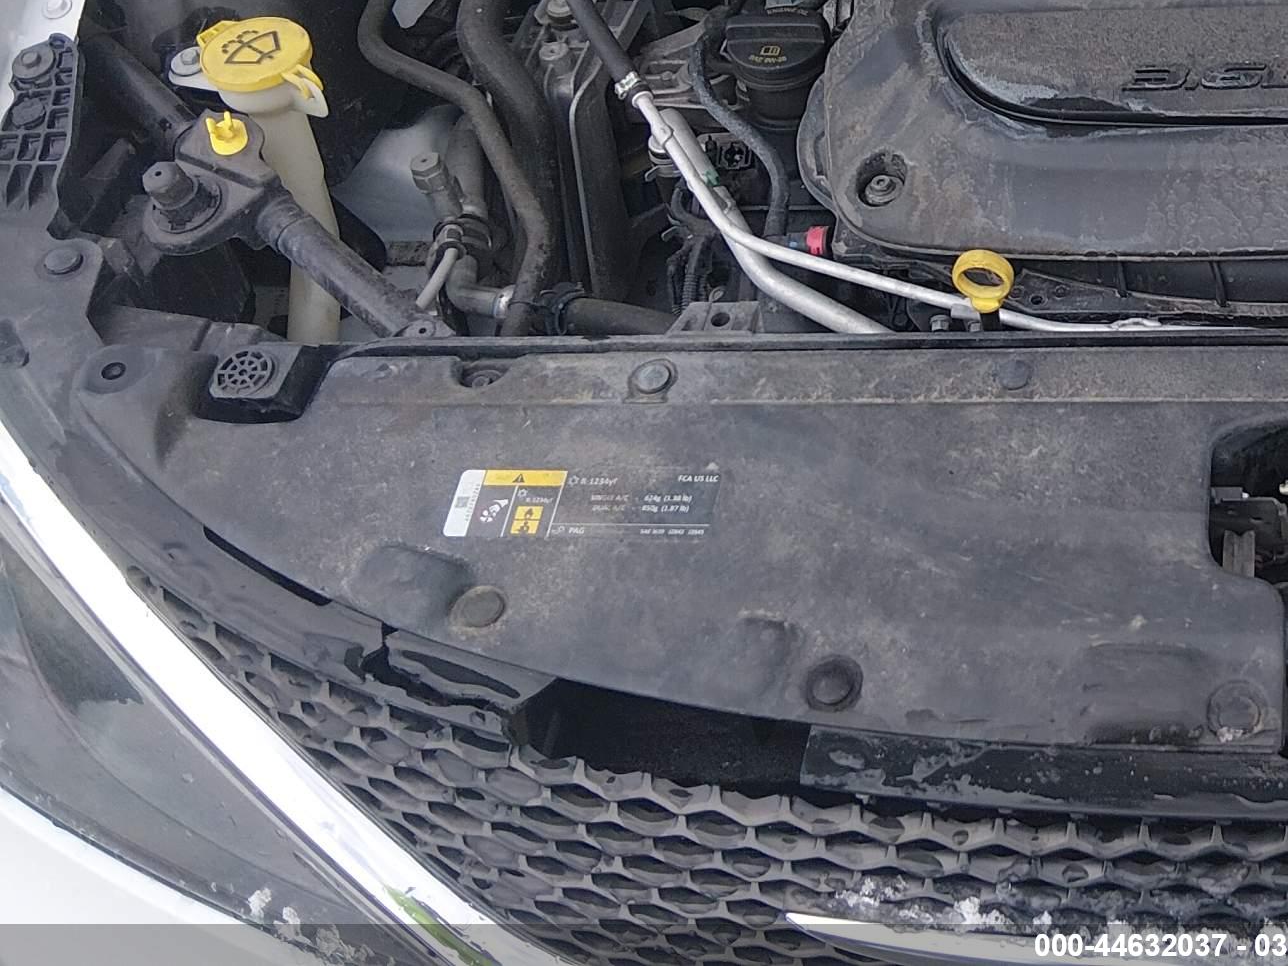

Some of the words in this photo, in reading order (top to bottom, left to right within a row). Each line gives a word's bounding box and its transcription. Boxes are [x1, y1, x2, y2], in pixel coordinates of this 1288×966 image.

[678, 474, 693, 483] FCA
[693, 474, 705, 483] US
[705, 474, 720, 483] LLC
[568, 526, 585, 535] PAG
